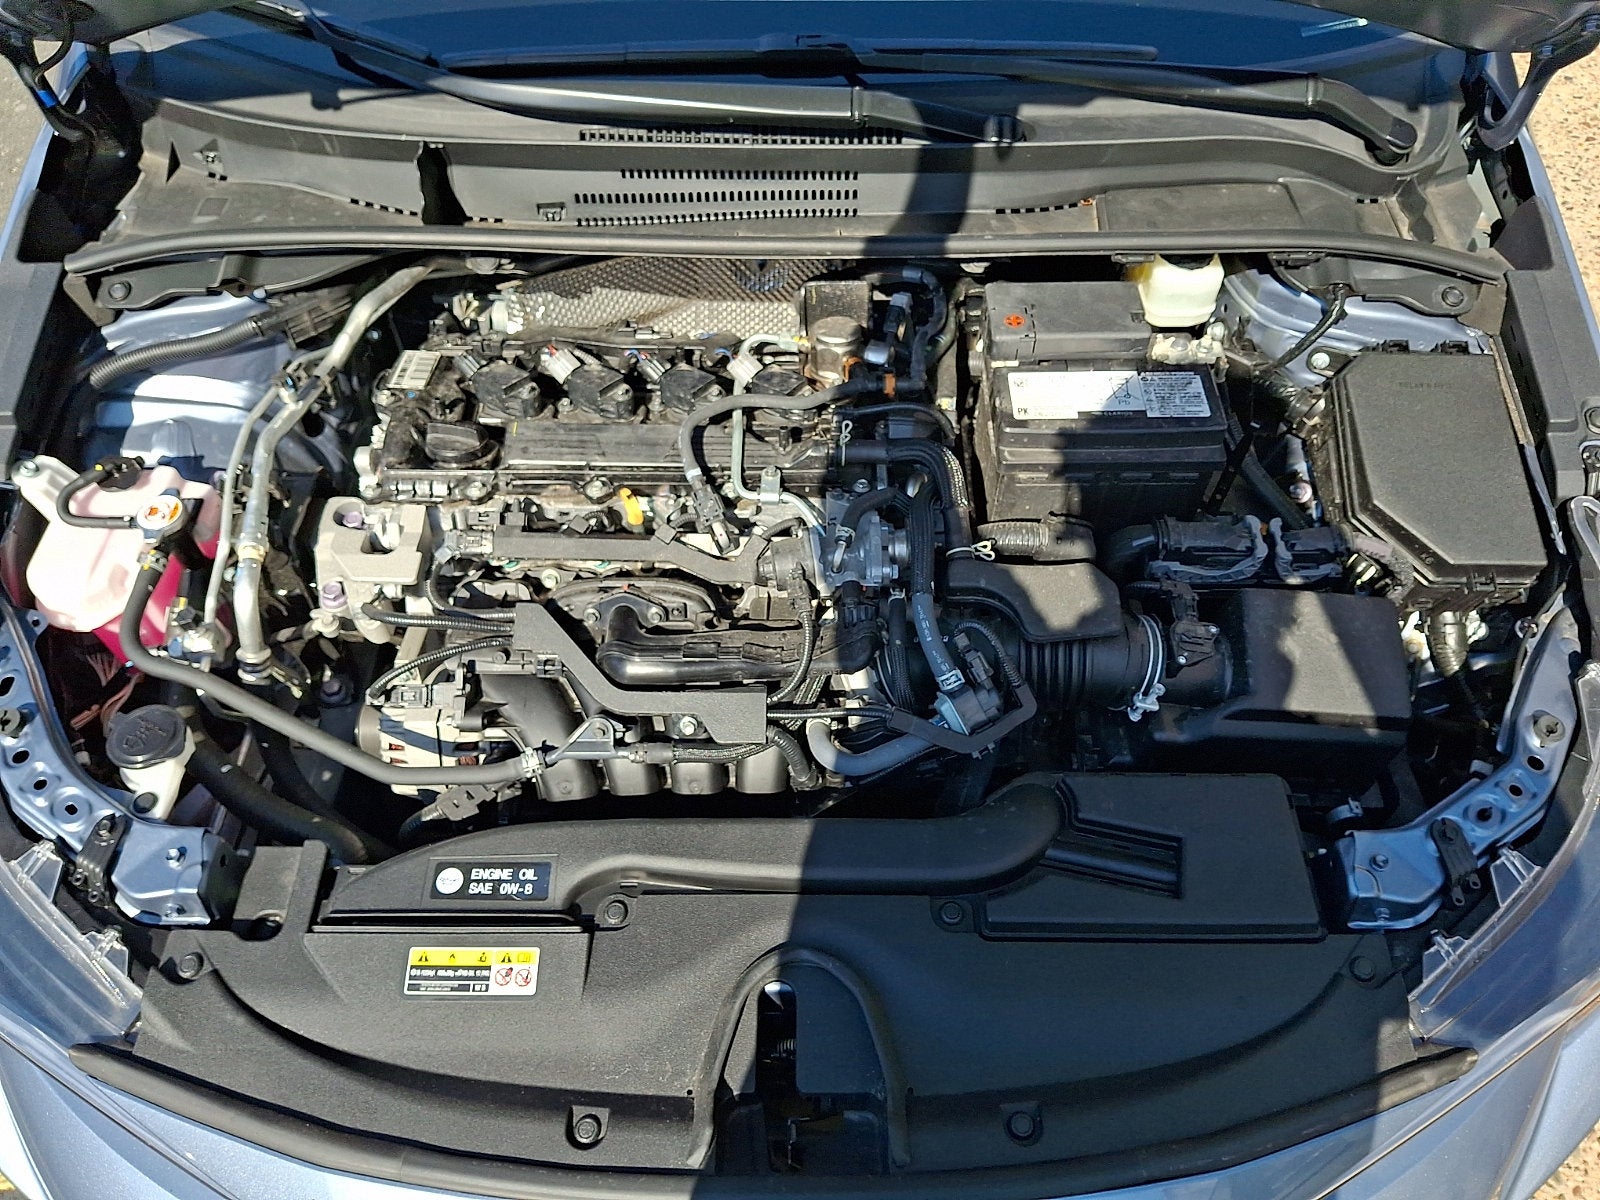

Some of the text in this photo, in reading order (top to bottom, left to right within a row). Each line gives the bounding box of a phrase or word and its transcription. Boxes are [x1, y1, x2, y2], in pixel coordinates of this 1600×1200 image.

[470, 868, 538, 880] ENGINE OIL
[468, 882, 533, 895] SAE 0W-8
